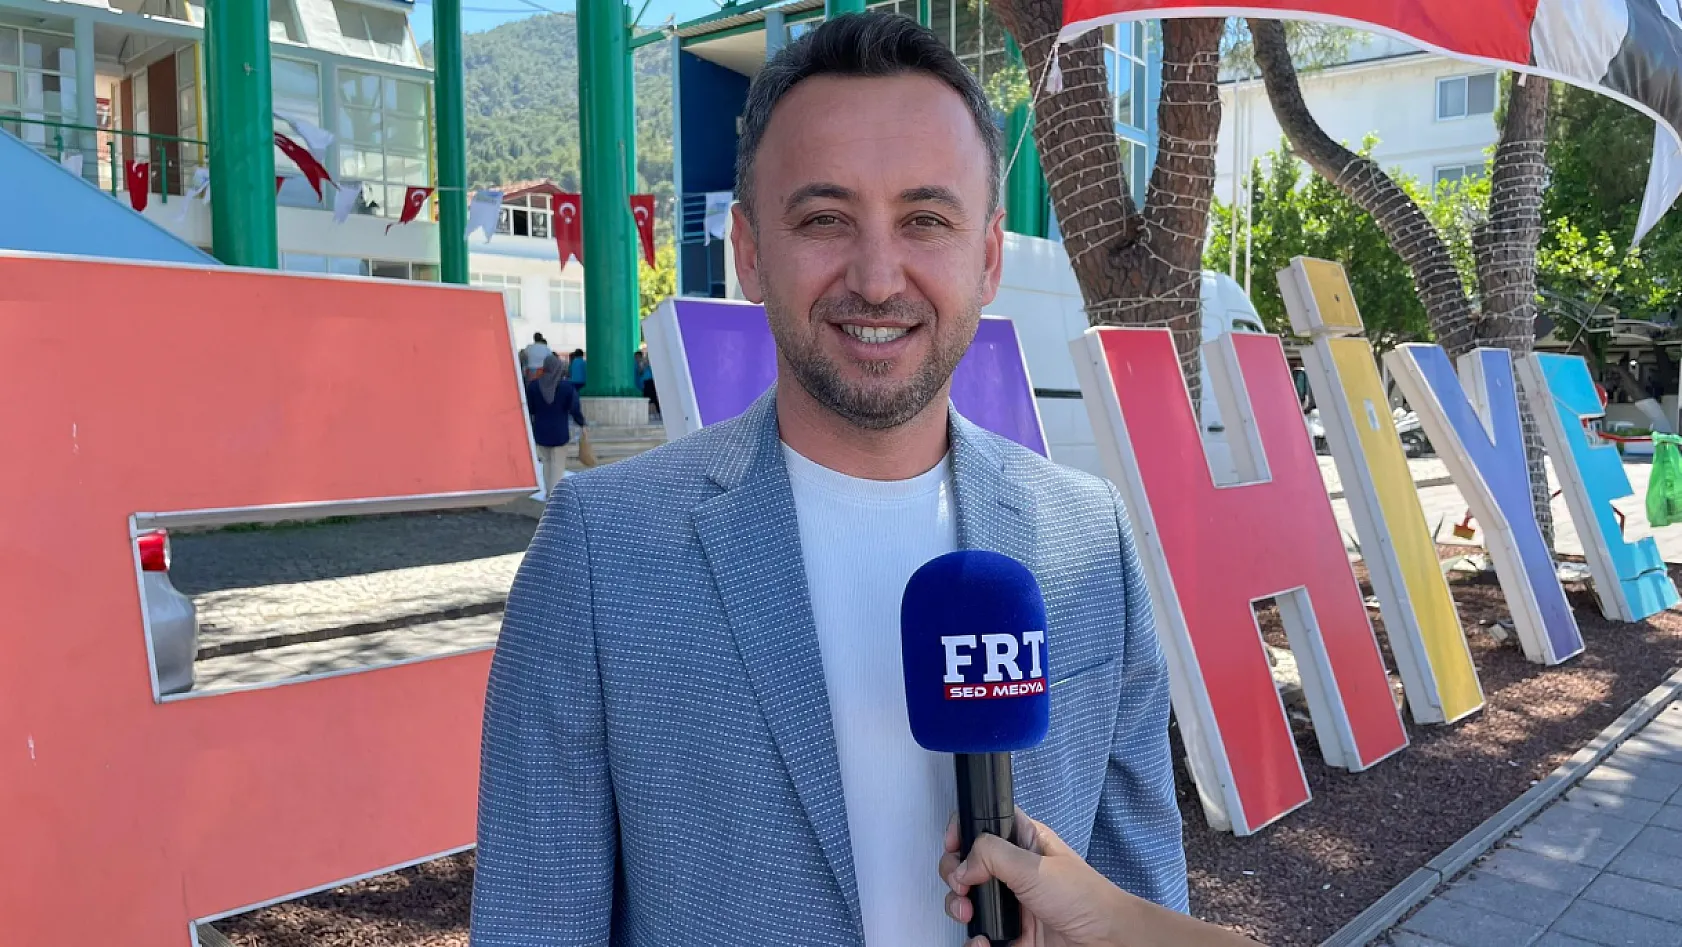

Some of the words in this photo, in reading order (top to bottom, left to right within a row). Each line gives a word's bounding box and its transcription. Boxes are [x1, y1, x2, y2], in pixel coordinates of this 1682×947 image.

[940, 630, 1045, 683] FRT
[949, 686, 987, 698] SED
[992, 681, 1044, 697] MEDYA
